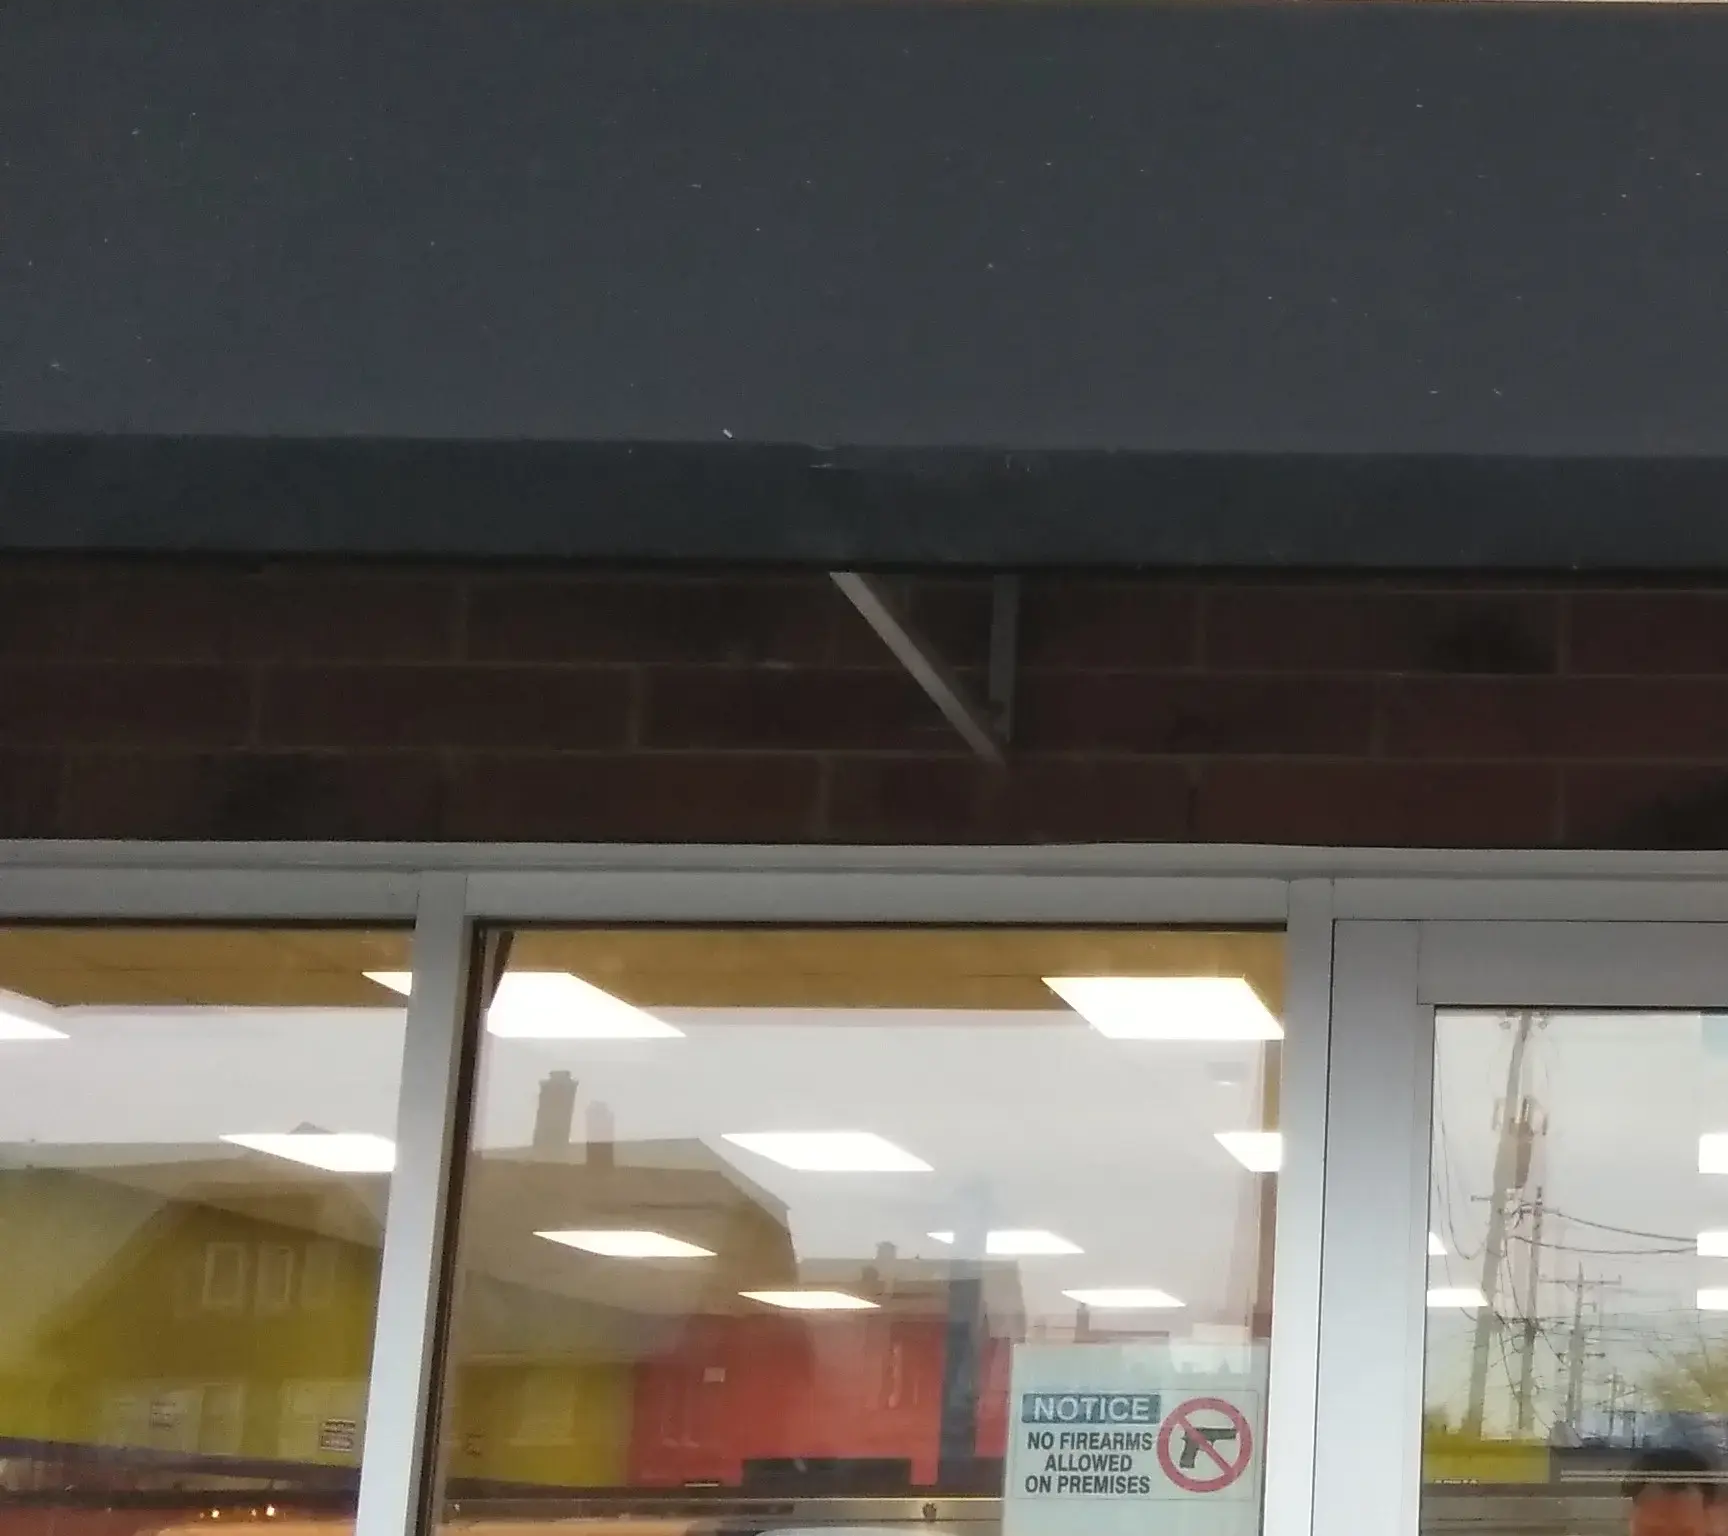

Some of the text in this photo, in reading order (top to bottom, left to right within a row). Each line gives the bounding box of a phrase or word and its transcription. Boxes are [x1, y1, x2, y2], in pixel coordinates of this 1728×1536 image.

[1034, 1396, 1150, 1422] NOTICE
[1027, 1431, 1153, 1451] NO FIREARMS
[1044, 1454, 1133, 1472] ALLOWED
[1024, 1475, 1150, 1494] ON PREMISES
